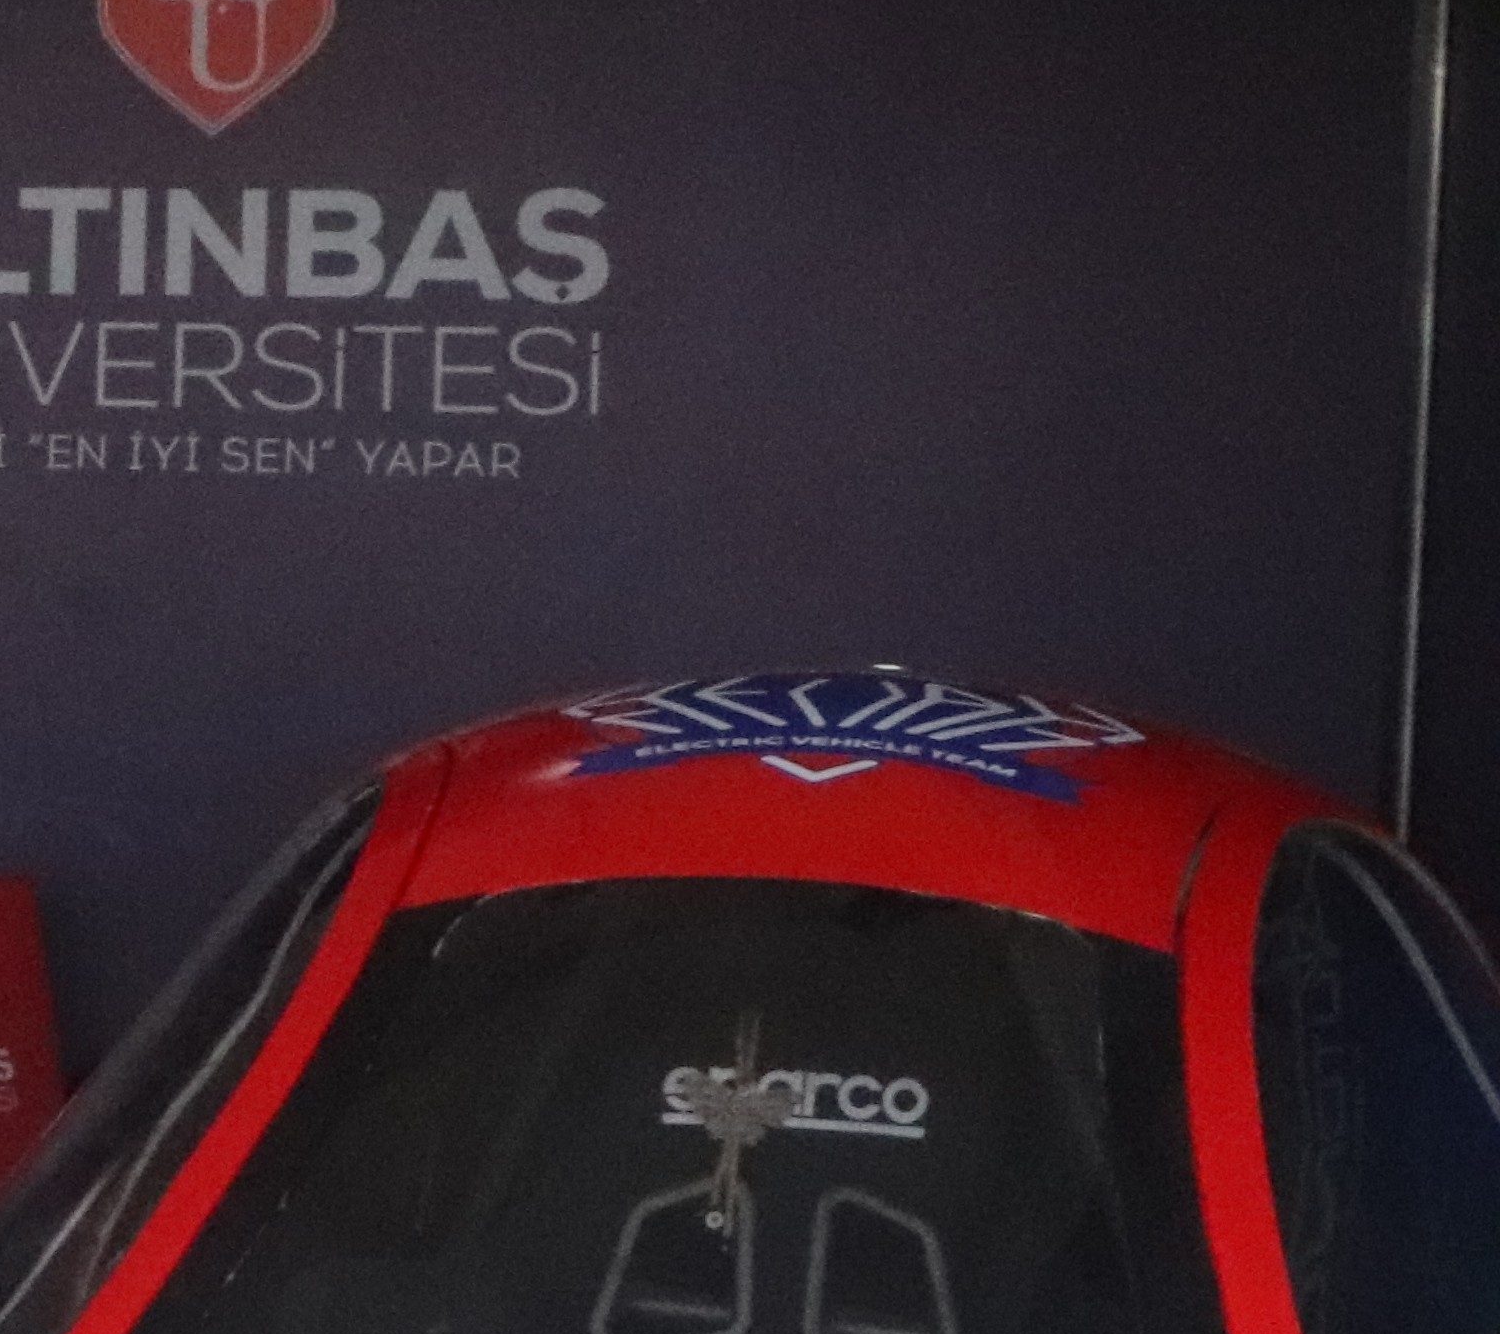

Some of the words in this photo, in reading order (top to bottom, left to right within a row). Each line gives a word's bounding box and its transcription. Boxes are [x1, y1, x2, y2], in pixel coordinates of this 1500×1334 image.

[356, 440, 521, 479] YAPAR
[634, 735, 785, 758] ELECTRIC
[791, 735, 923, 757] VEHICLE
[931, 748, 1018, 778] TEAM
[661, 1065, 927, 1125] sarco
